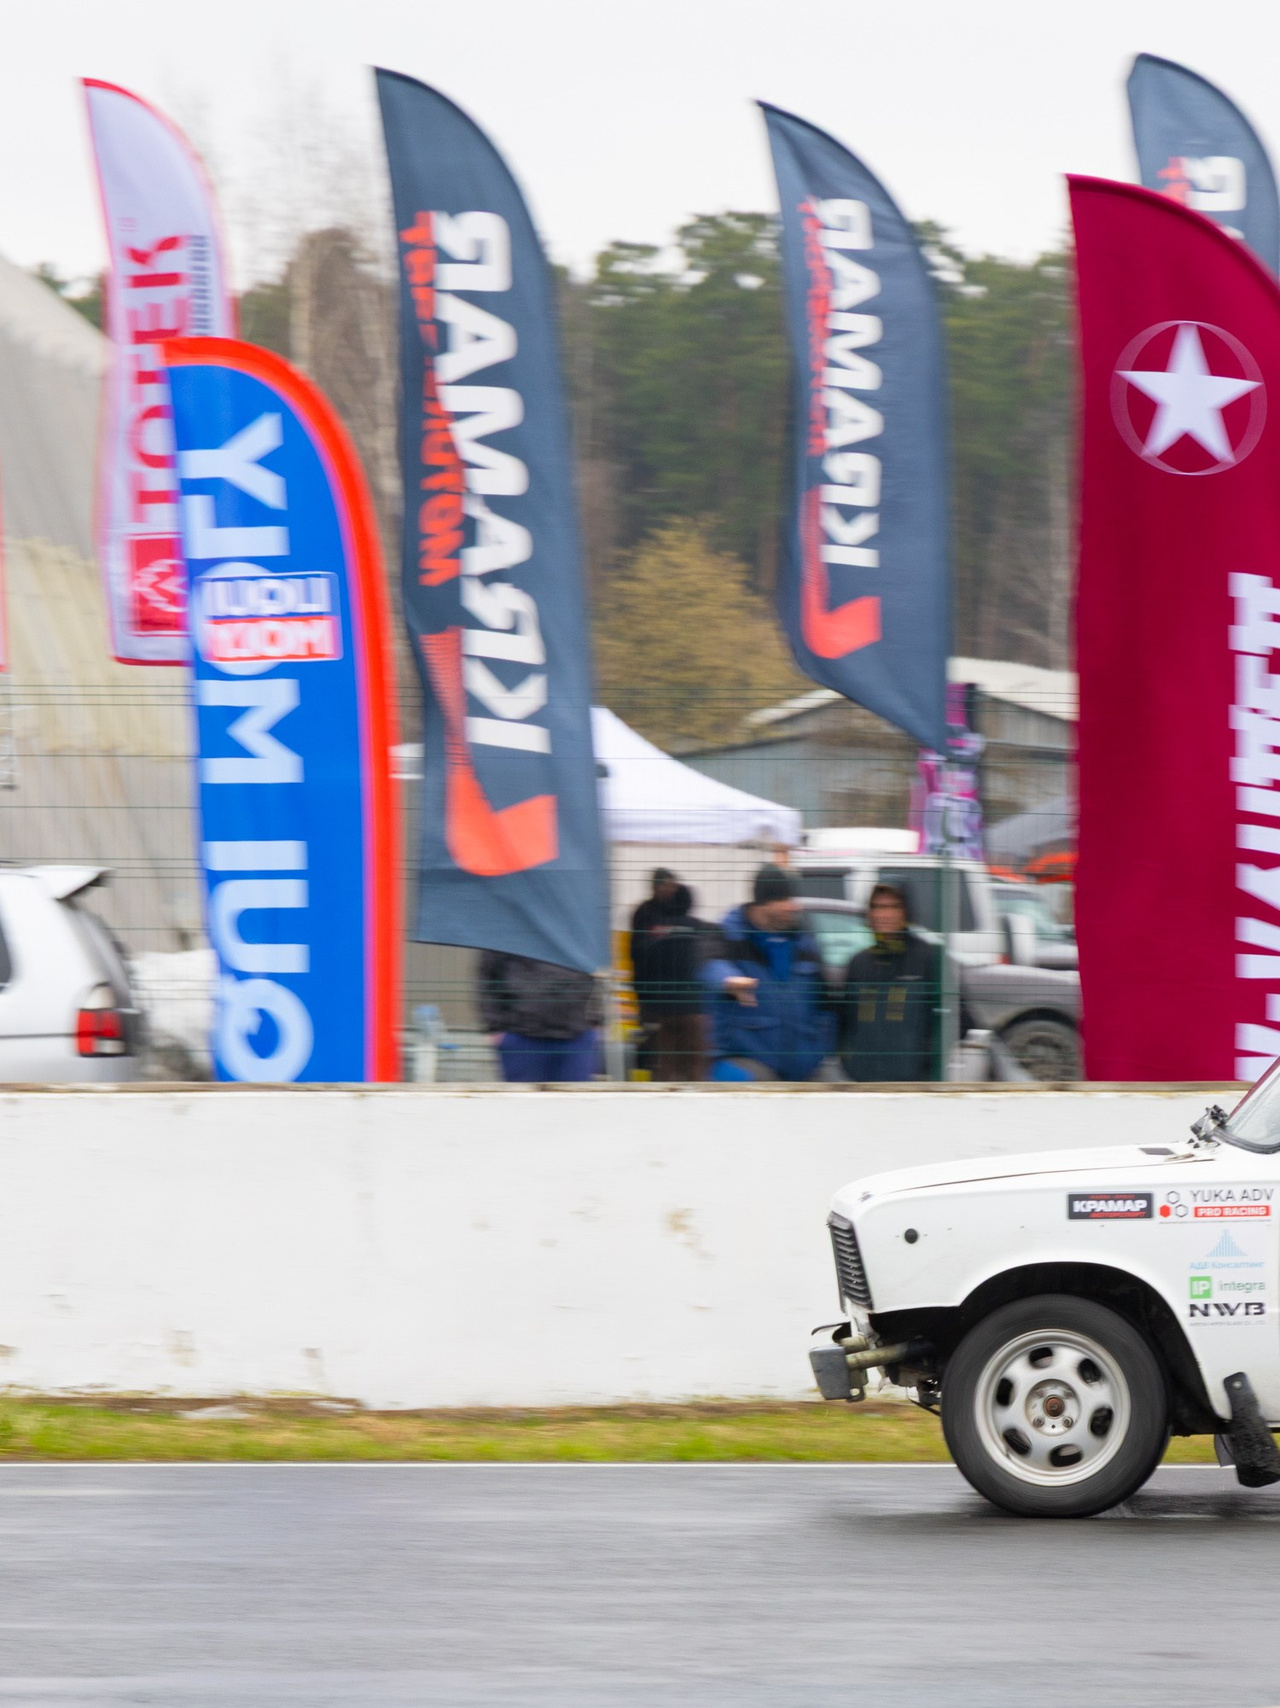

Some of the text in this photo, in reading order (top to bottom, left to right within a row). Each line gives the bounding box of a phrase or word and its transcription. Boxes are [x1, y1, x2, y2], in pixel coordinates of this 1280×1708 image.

[1190, 1188, 1275, 1202] YUKA ADV
[1073, 1199, 1148, 1212] КРАМАР
[1197, 1206, 1267, 1216] PRO RACING
[1191, 1280, 1266, 1296] IP integra
[1189, 1302, 1266, 1318] NWB
